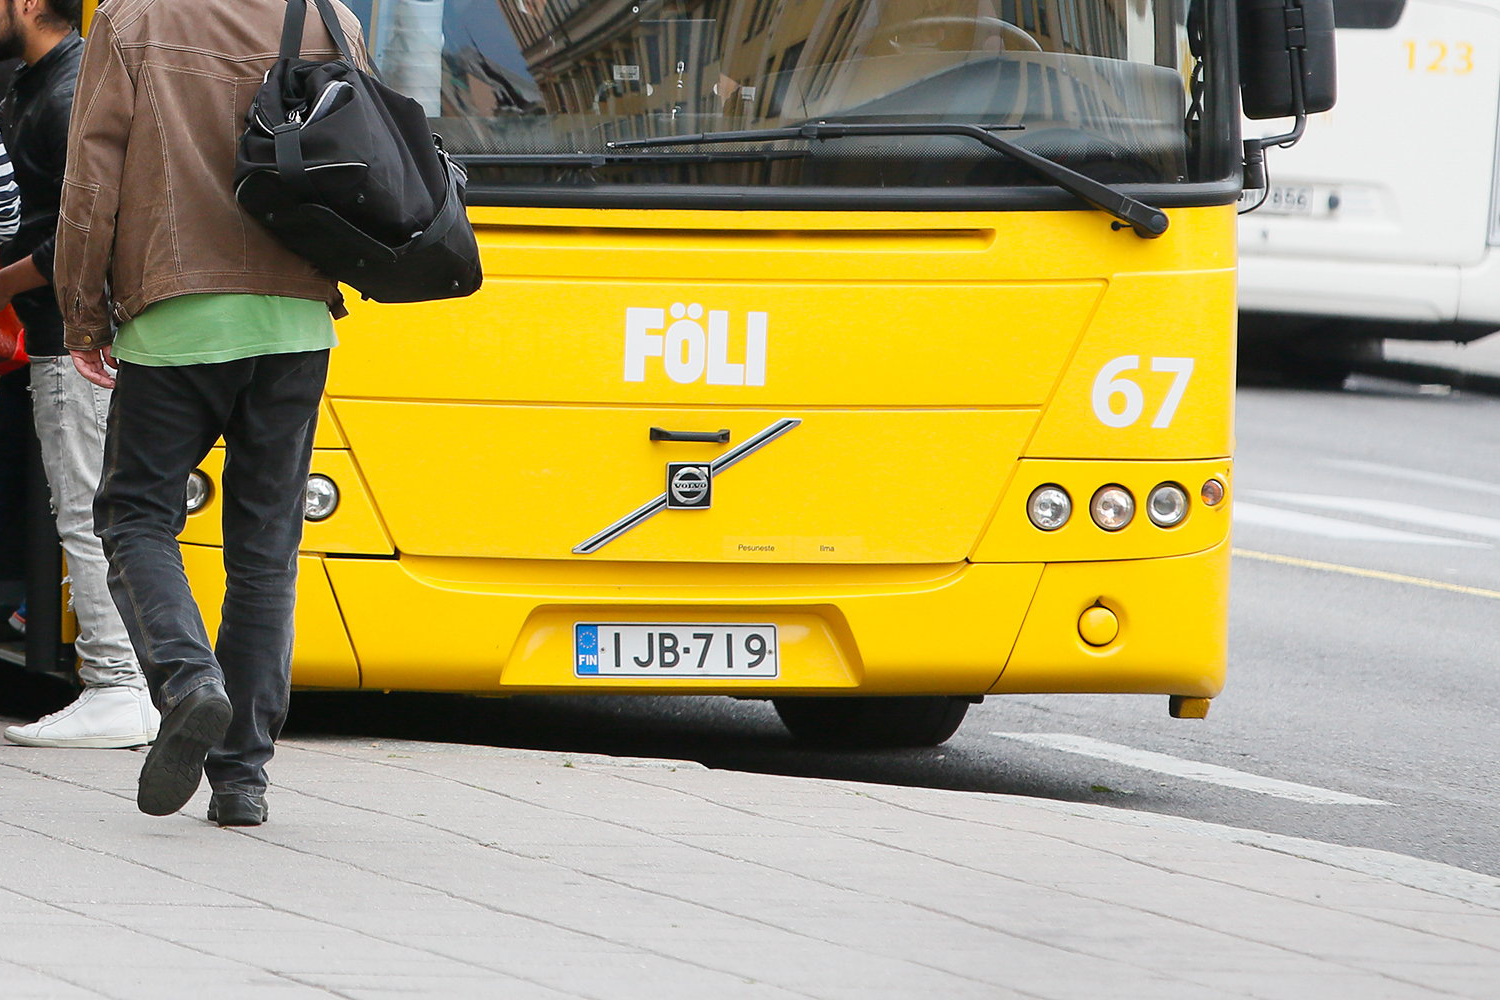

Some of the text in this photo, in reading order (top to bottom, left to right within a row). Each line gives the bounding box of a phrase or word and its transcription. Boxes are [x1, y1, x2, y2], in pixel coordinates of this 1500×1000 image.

[1403, 39, 1474, 75] 123
[623, 302, 768, 387] FÖLI
[1091, 355, 1196, 429] 67
[674, 482, 707, 490] VOLVO
[738, 543, 775, 552] Pesuneste
[819, 544, 835, 552] Ilma
[579, 655, 597, 666] FIN
